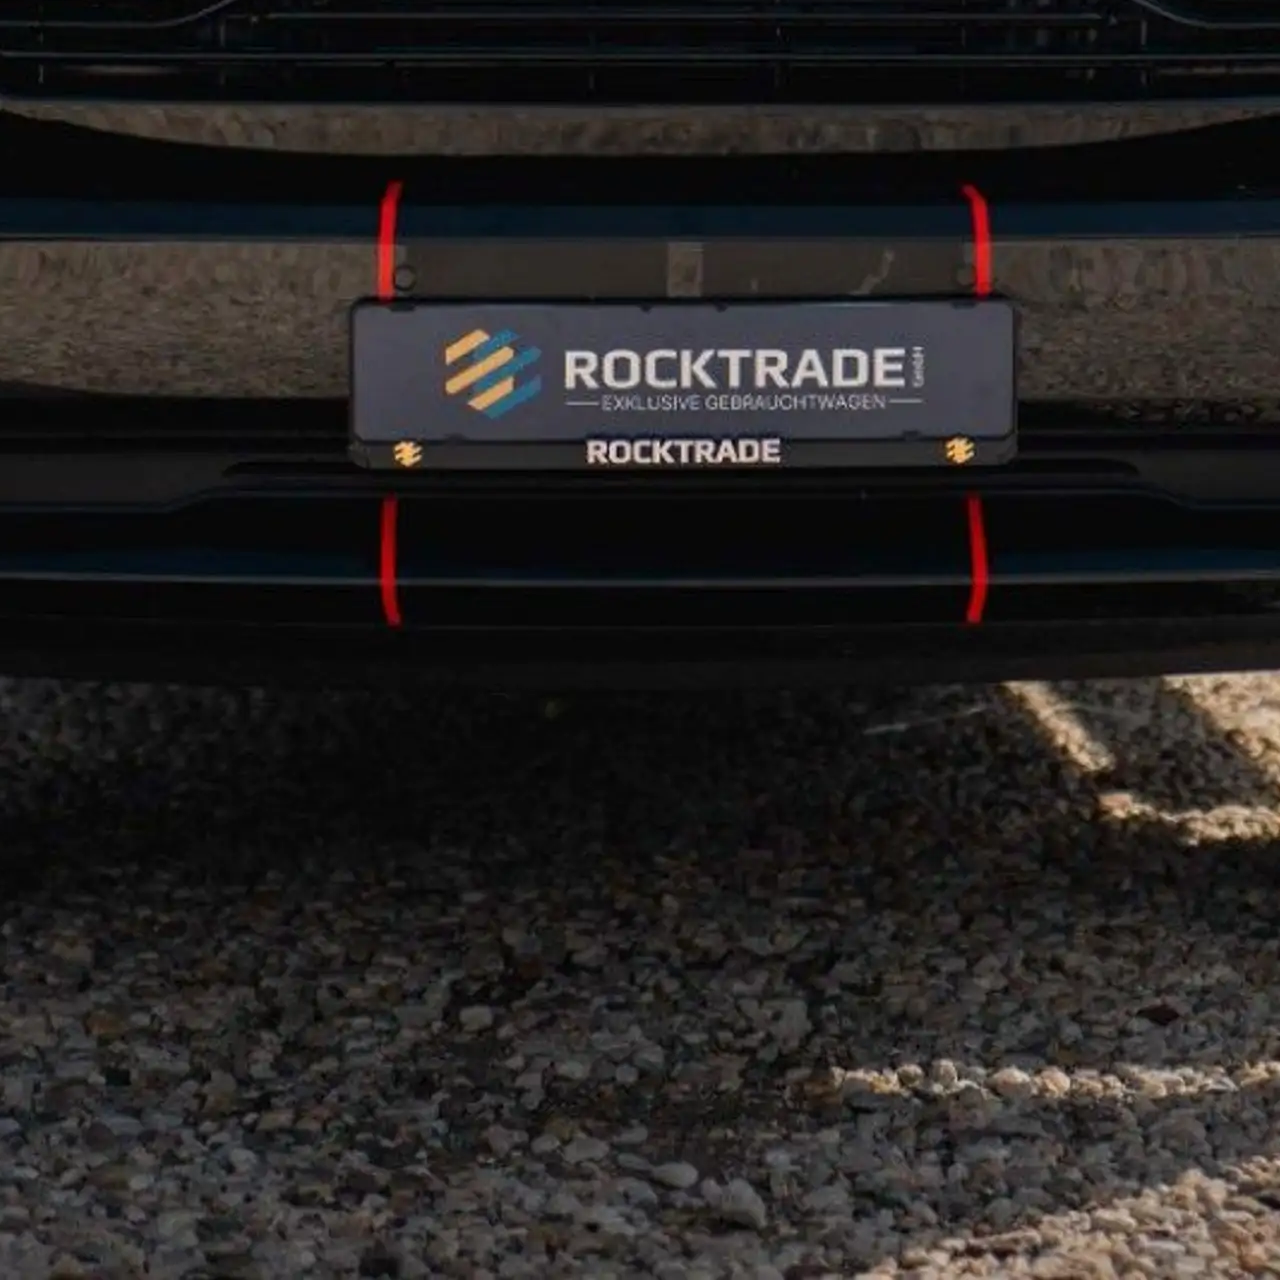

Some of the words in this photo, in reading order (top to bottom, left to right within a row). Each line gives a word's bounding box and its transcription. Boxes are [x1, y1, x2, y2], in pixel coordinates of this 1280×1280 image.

[565, 348, 905, 389] ROCKTRADE
[602, 394, 700, 411] EXKLUSIVE
[705, 394, 886, 410] GEBRAUCHTWAGEN
[587, 439, 781, 464] ROCKTRADE
